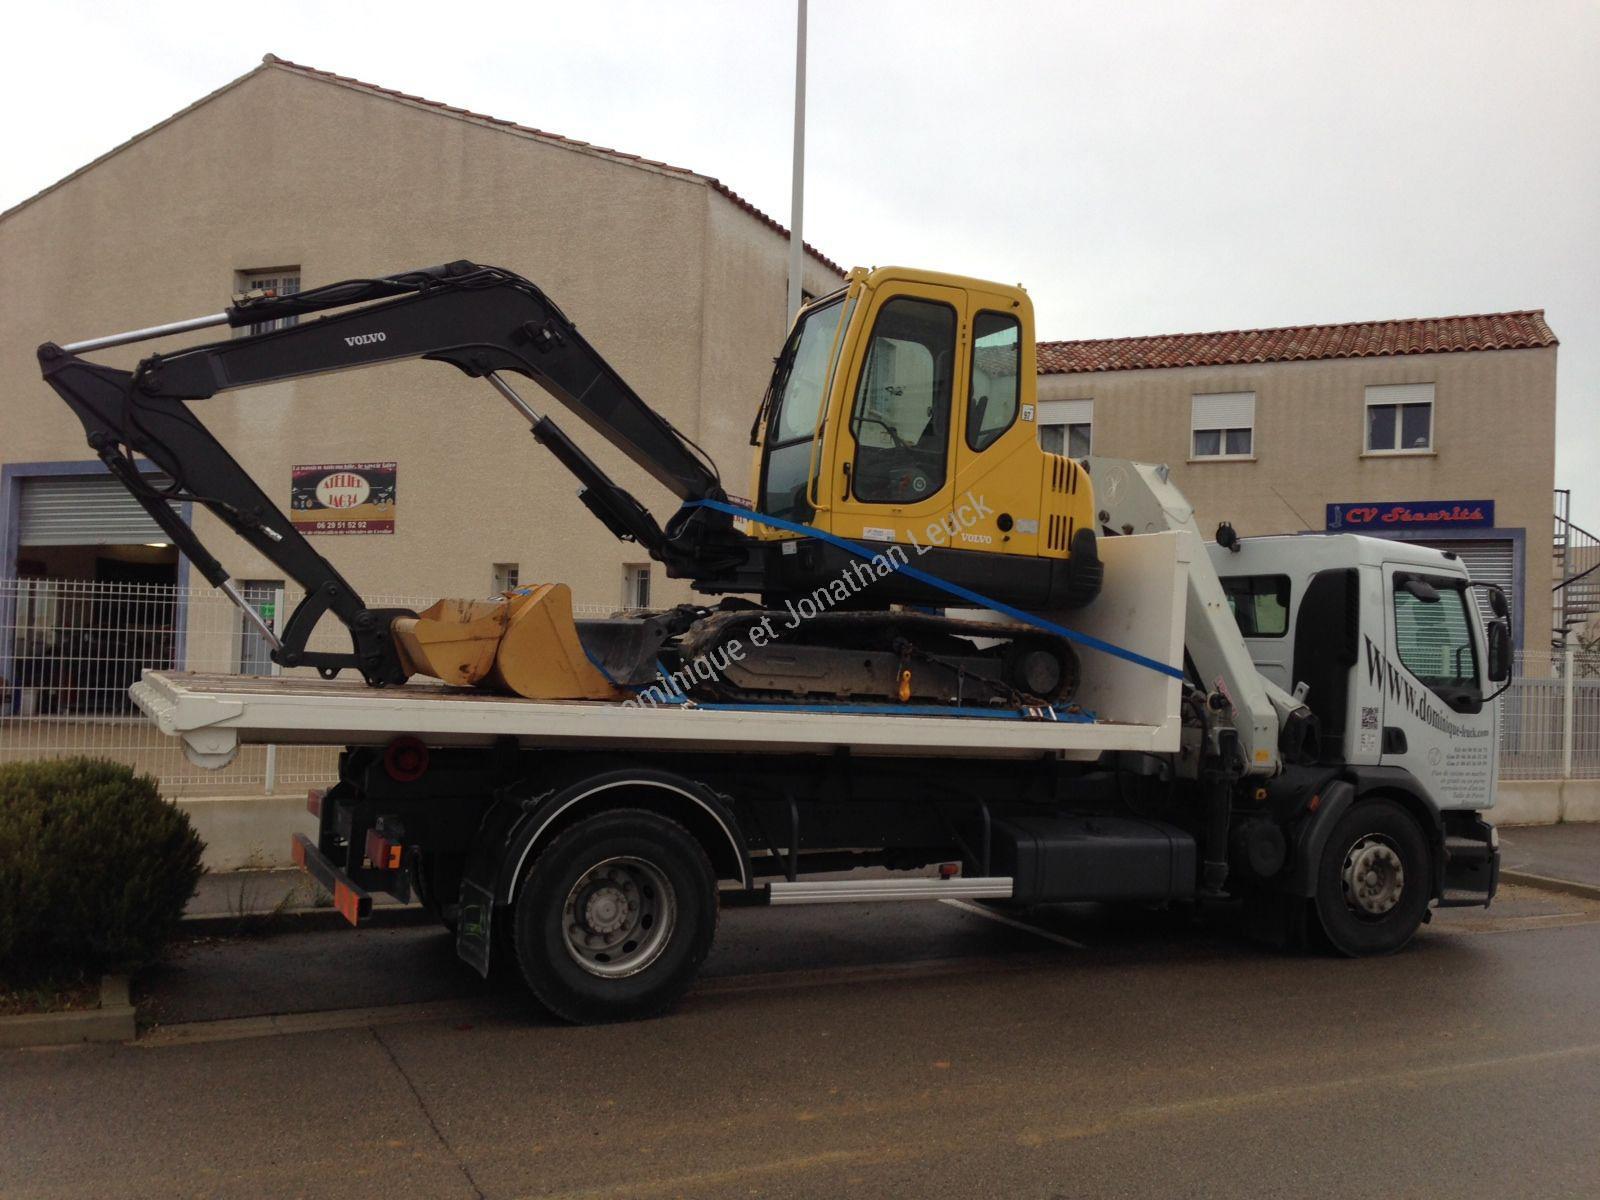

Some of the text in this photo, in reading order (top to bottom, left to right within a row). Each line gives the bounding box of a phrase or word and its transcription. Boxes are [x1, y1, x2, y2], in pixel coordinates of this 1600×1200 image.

[344, 332, 387, 346] VOLVO
[324, 475, 363, 489] ATELIER
[1346, 506, 1484, 523] CV Sécurité
[961, 533, 993, 545] VOLVO
